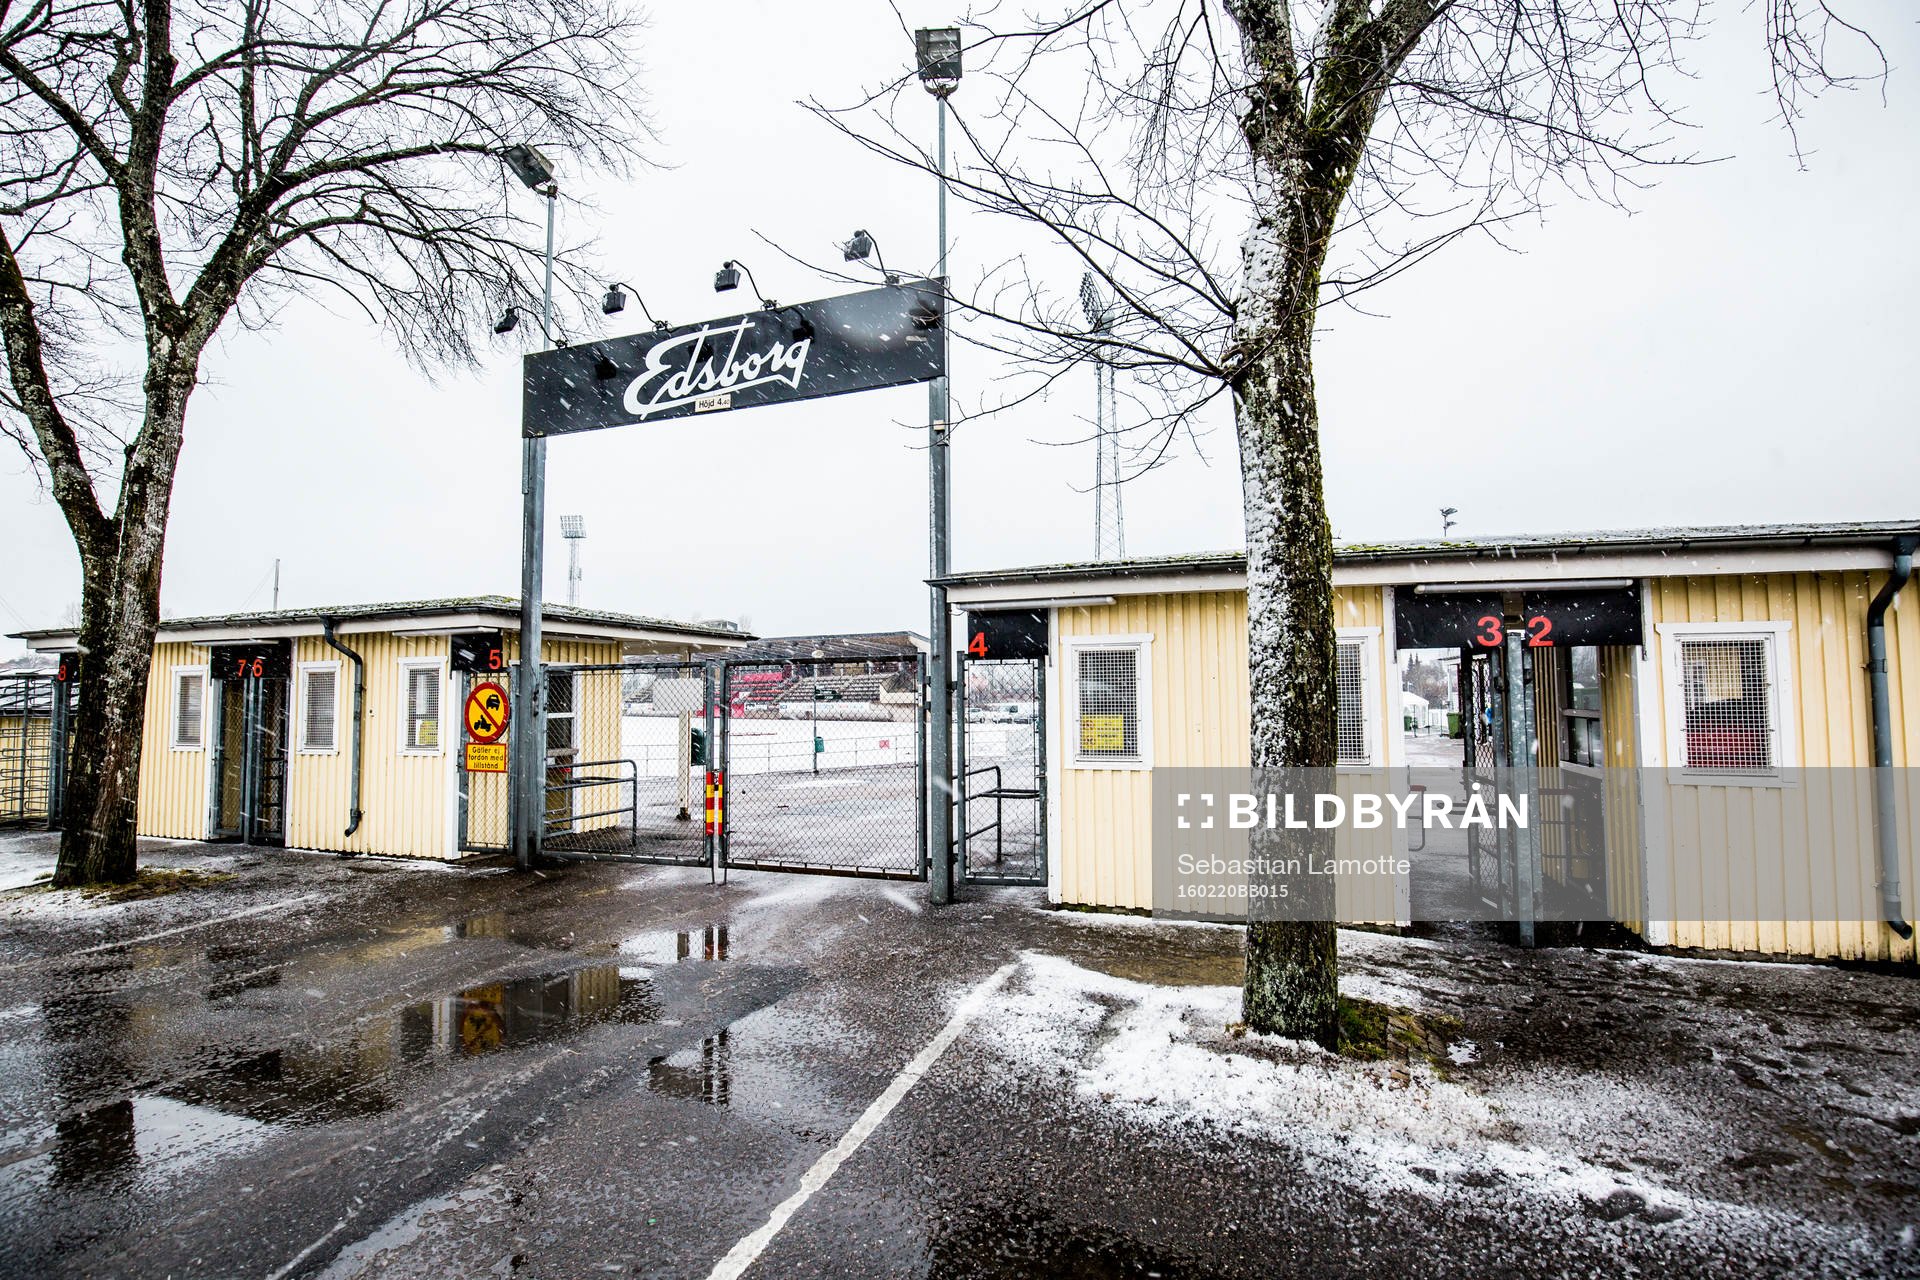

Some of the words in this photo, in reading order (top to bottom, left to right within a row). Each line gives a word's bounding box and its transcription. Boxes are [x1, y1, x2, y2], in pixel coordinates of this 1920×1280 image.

[623, 318, 811, 420] Edsborg
[698, 398, 715, 409] Höjd
[1476, 616, 1503, 647] 3
[1528, 616, 1554, 647] 2
[968, 631, 989, 657] 4
[237, 659, 247, 677] 7
[253, 658, 263, 677] 6
[489, 649, 501, 670] 5
